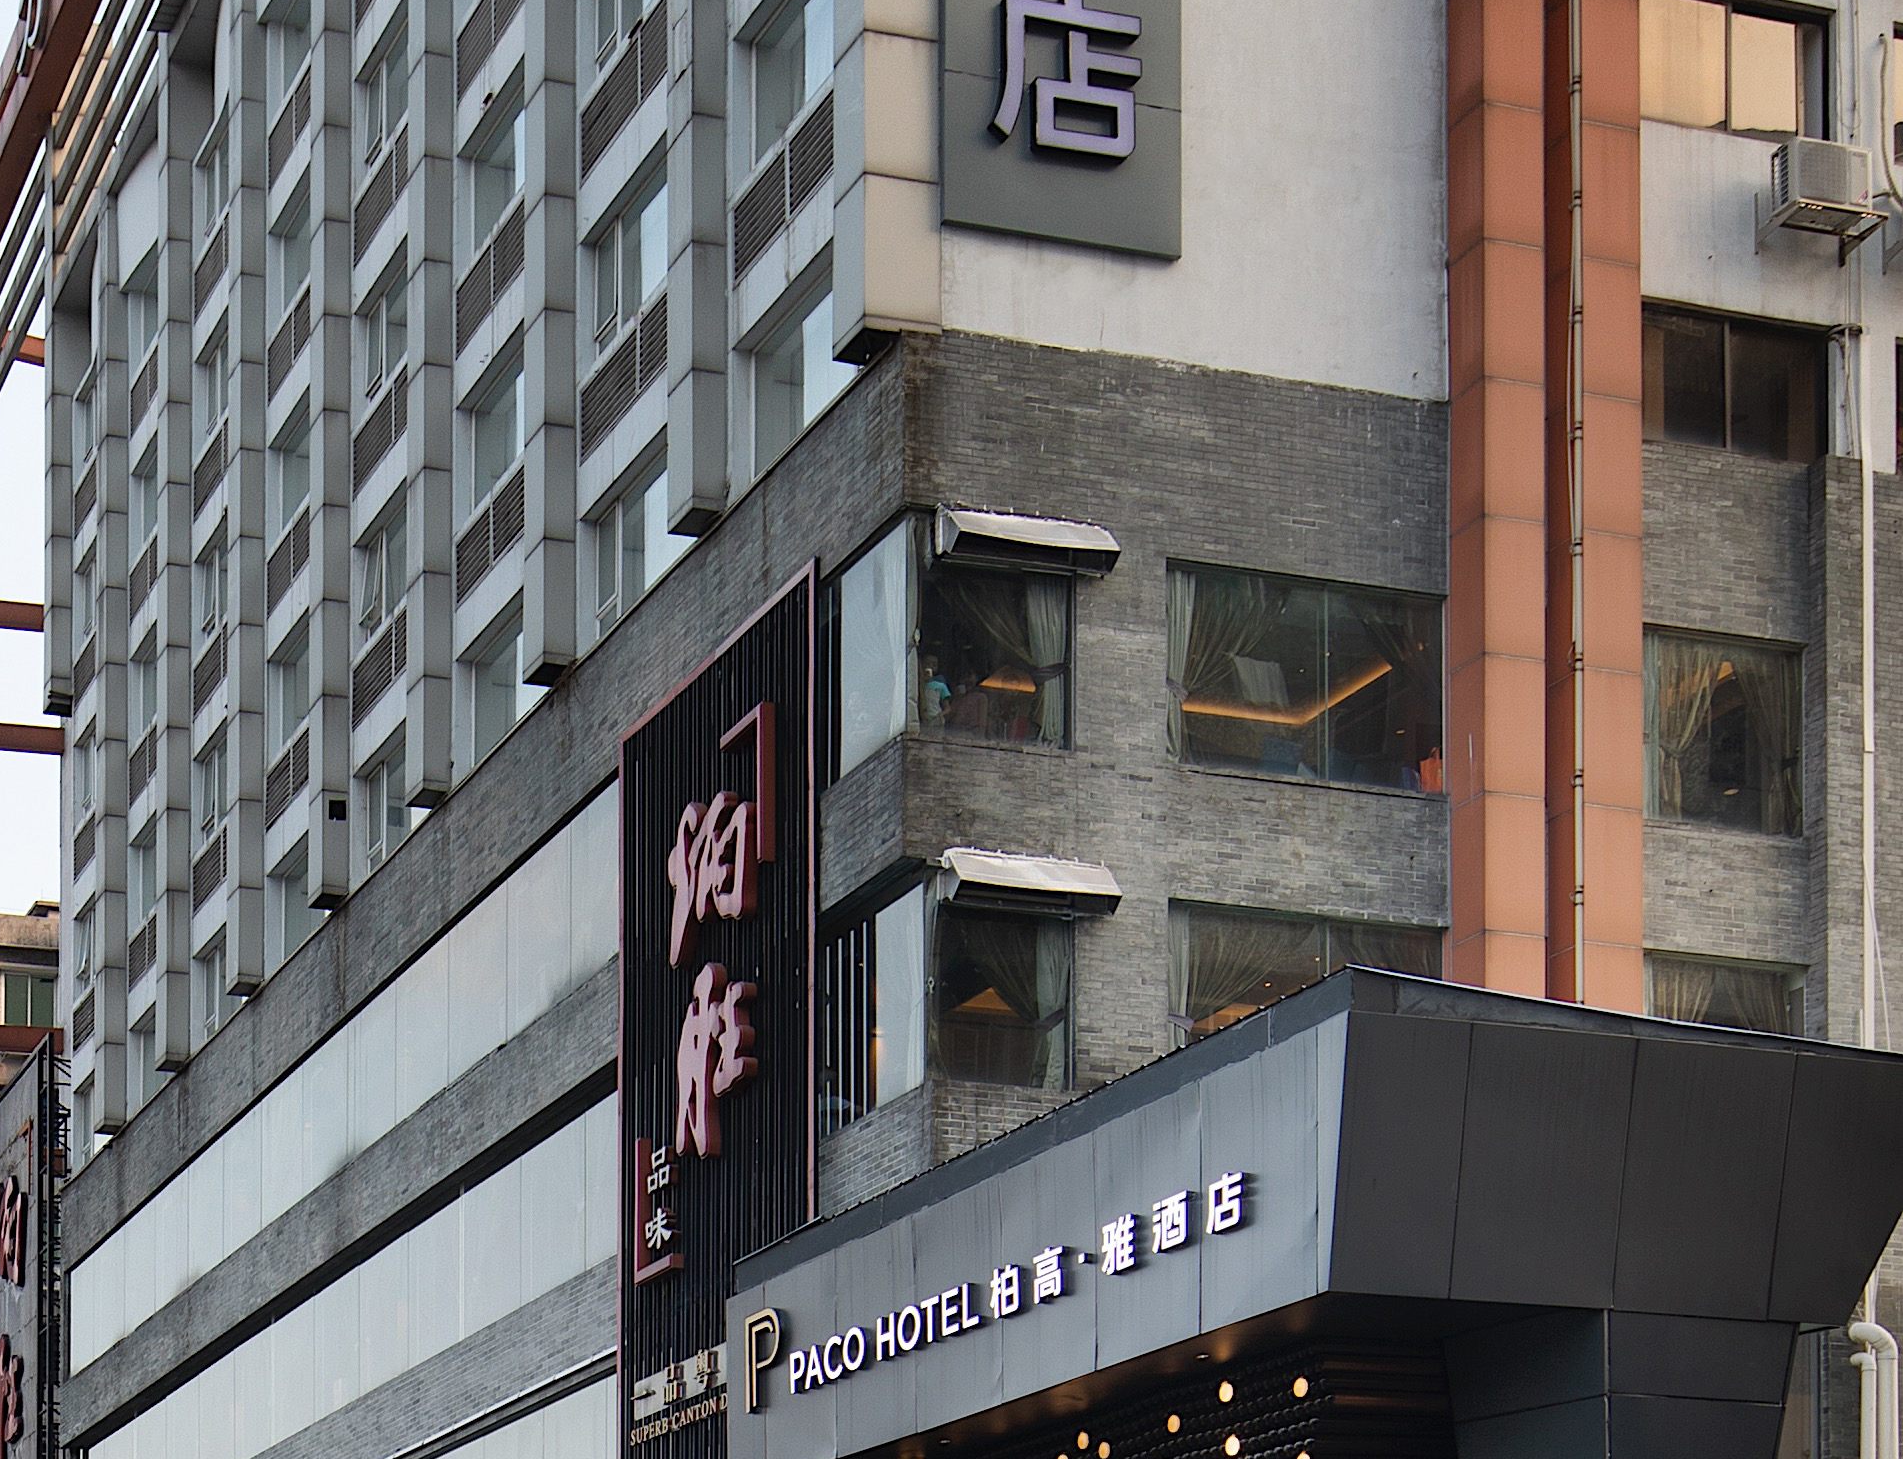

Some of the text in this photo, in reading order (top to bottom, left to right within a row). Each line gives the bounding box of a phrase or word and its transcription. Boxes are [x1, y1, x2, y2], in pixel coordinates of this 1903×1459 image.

[646, 1146, 673, 1250] 品味
[789, 1326, 865, 1394] PACO
[876, 1283, 980, 1361] HOTEL
[630, 1420, 669, 1446] SUPERB
[672, 1397, 718, 1430] CANTON
